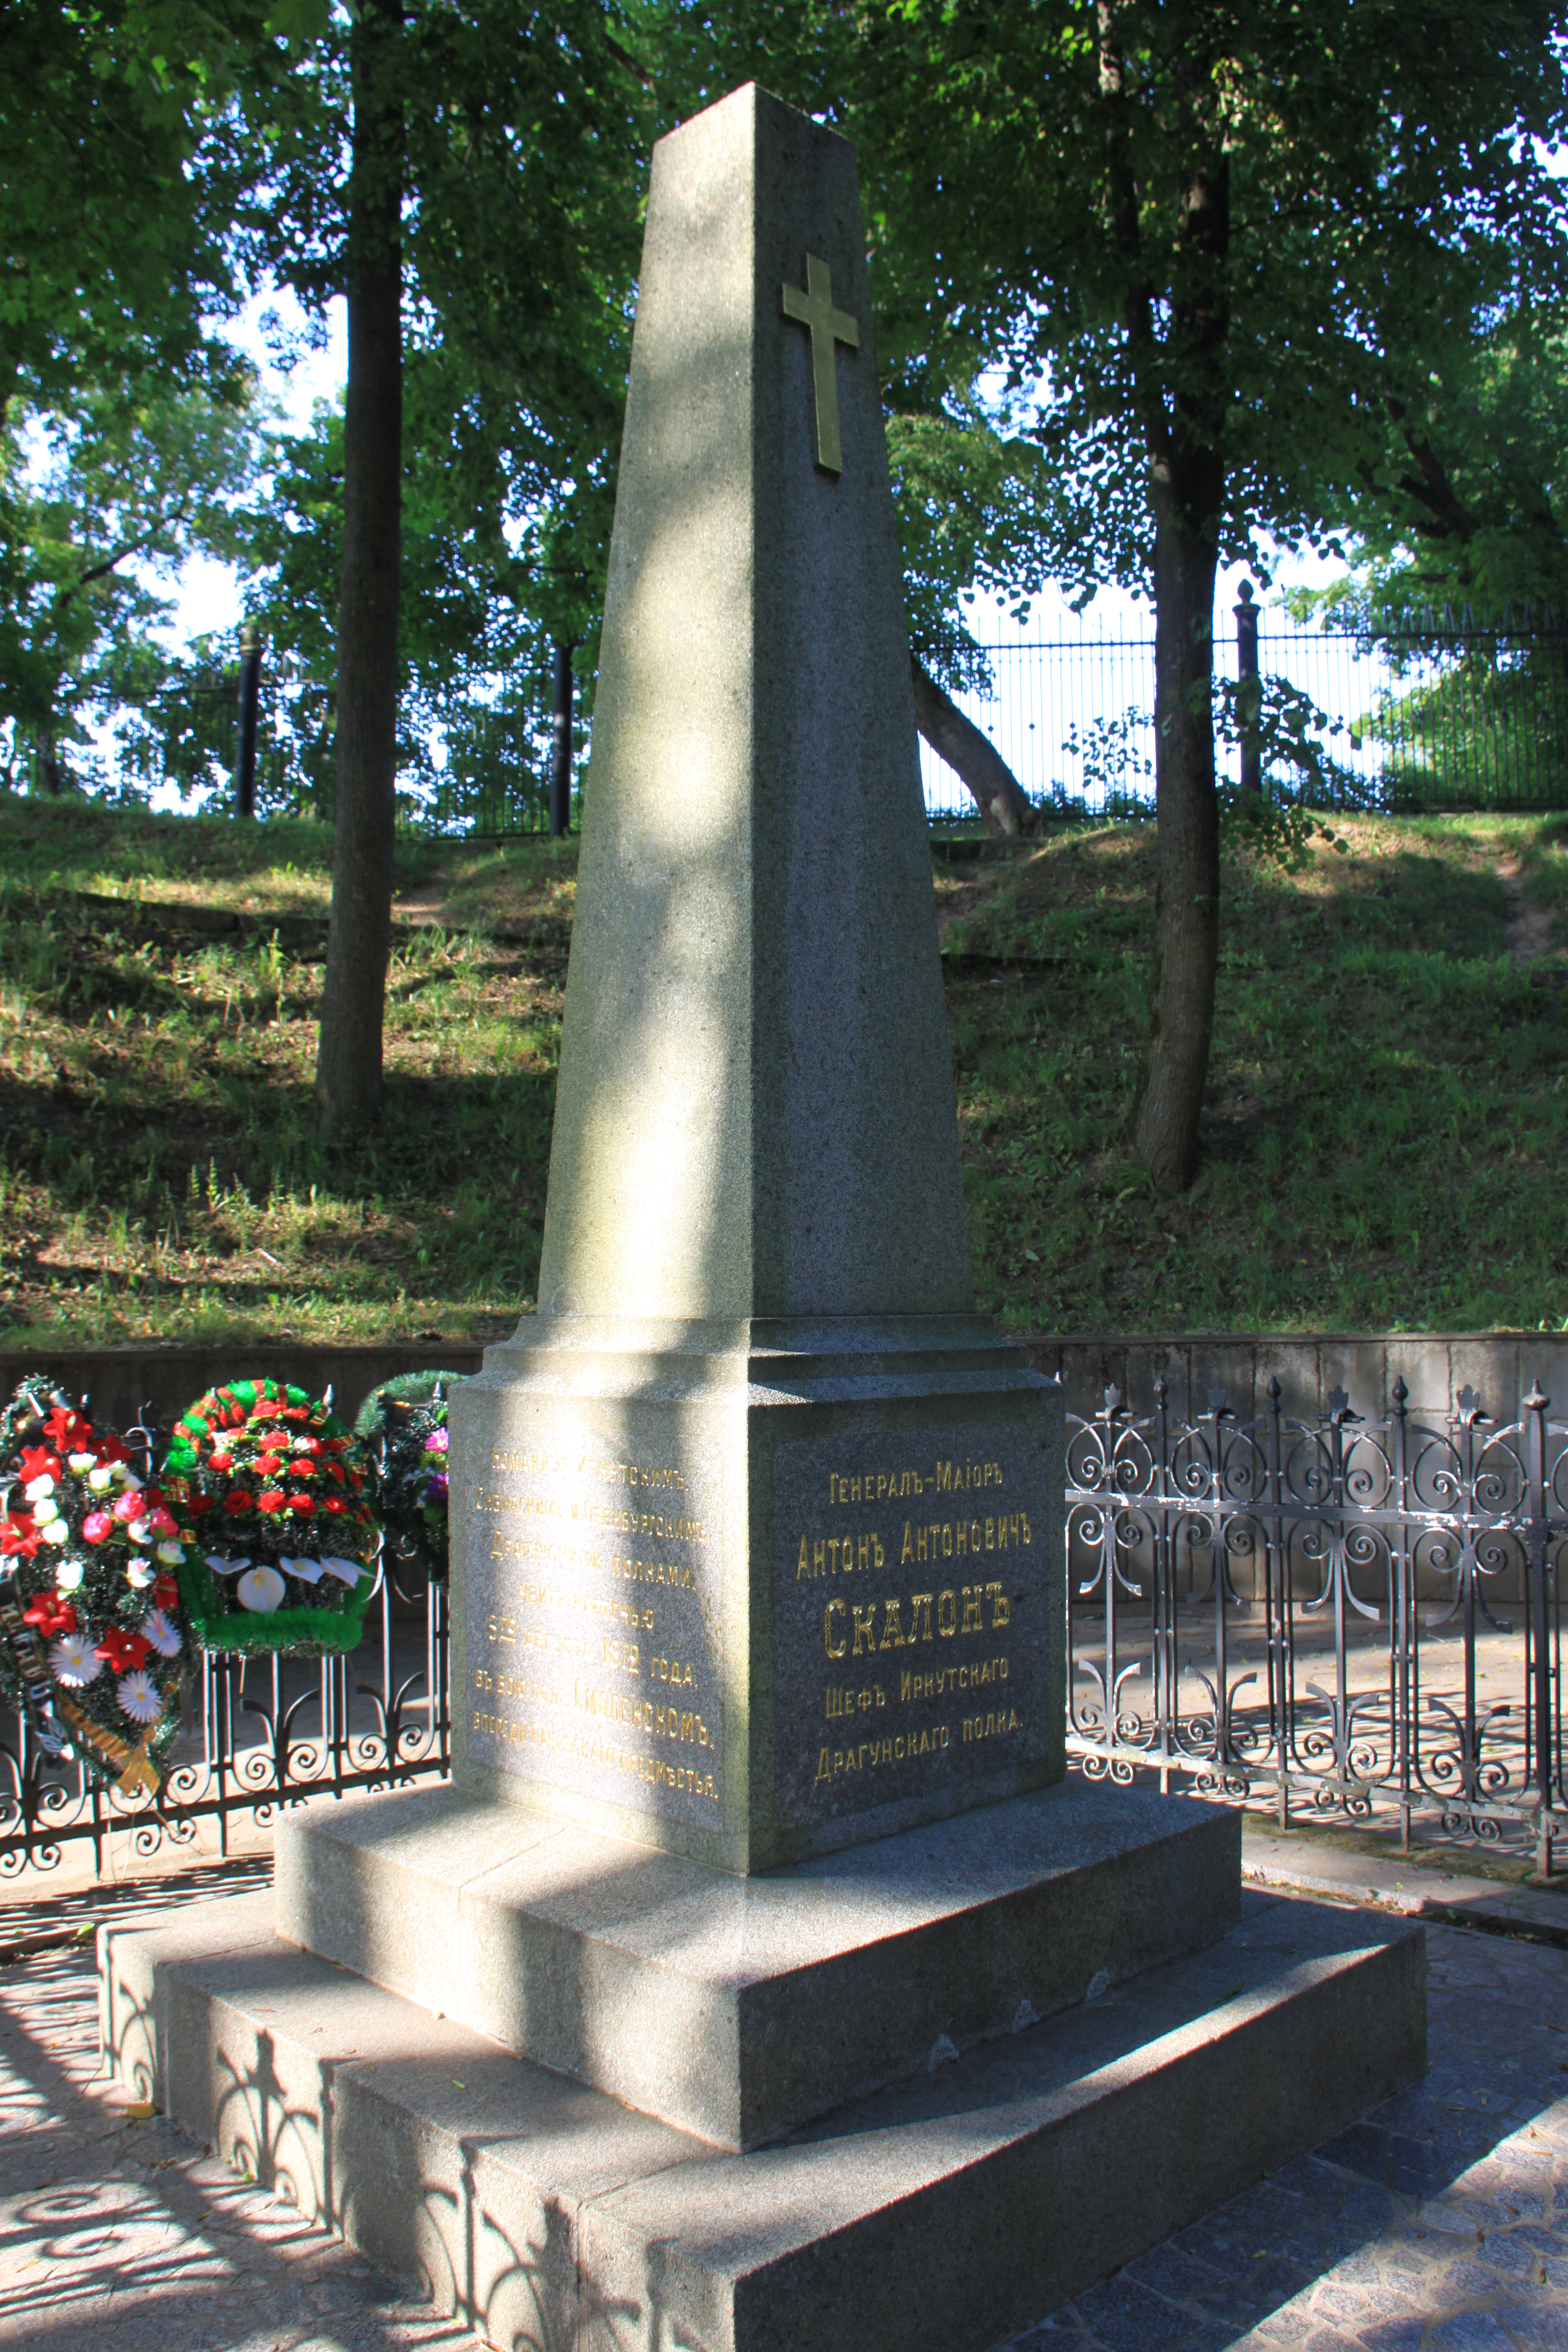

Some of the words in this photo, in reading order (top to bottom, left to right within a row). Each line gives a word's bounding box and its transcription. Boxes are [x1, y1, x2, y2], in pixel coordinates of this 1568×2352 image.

[796, 1532, 884, 1579] АНТОНЪ
[900, 1512, 1031, 1565] АНТОНОВИЧЪ
[825, 1581, 1010, 1659] СКАЛОНЪ
[602, 1636, 640, 1675] 1812
